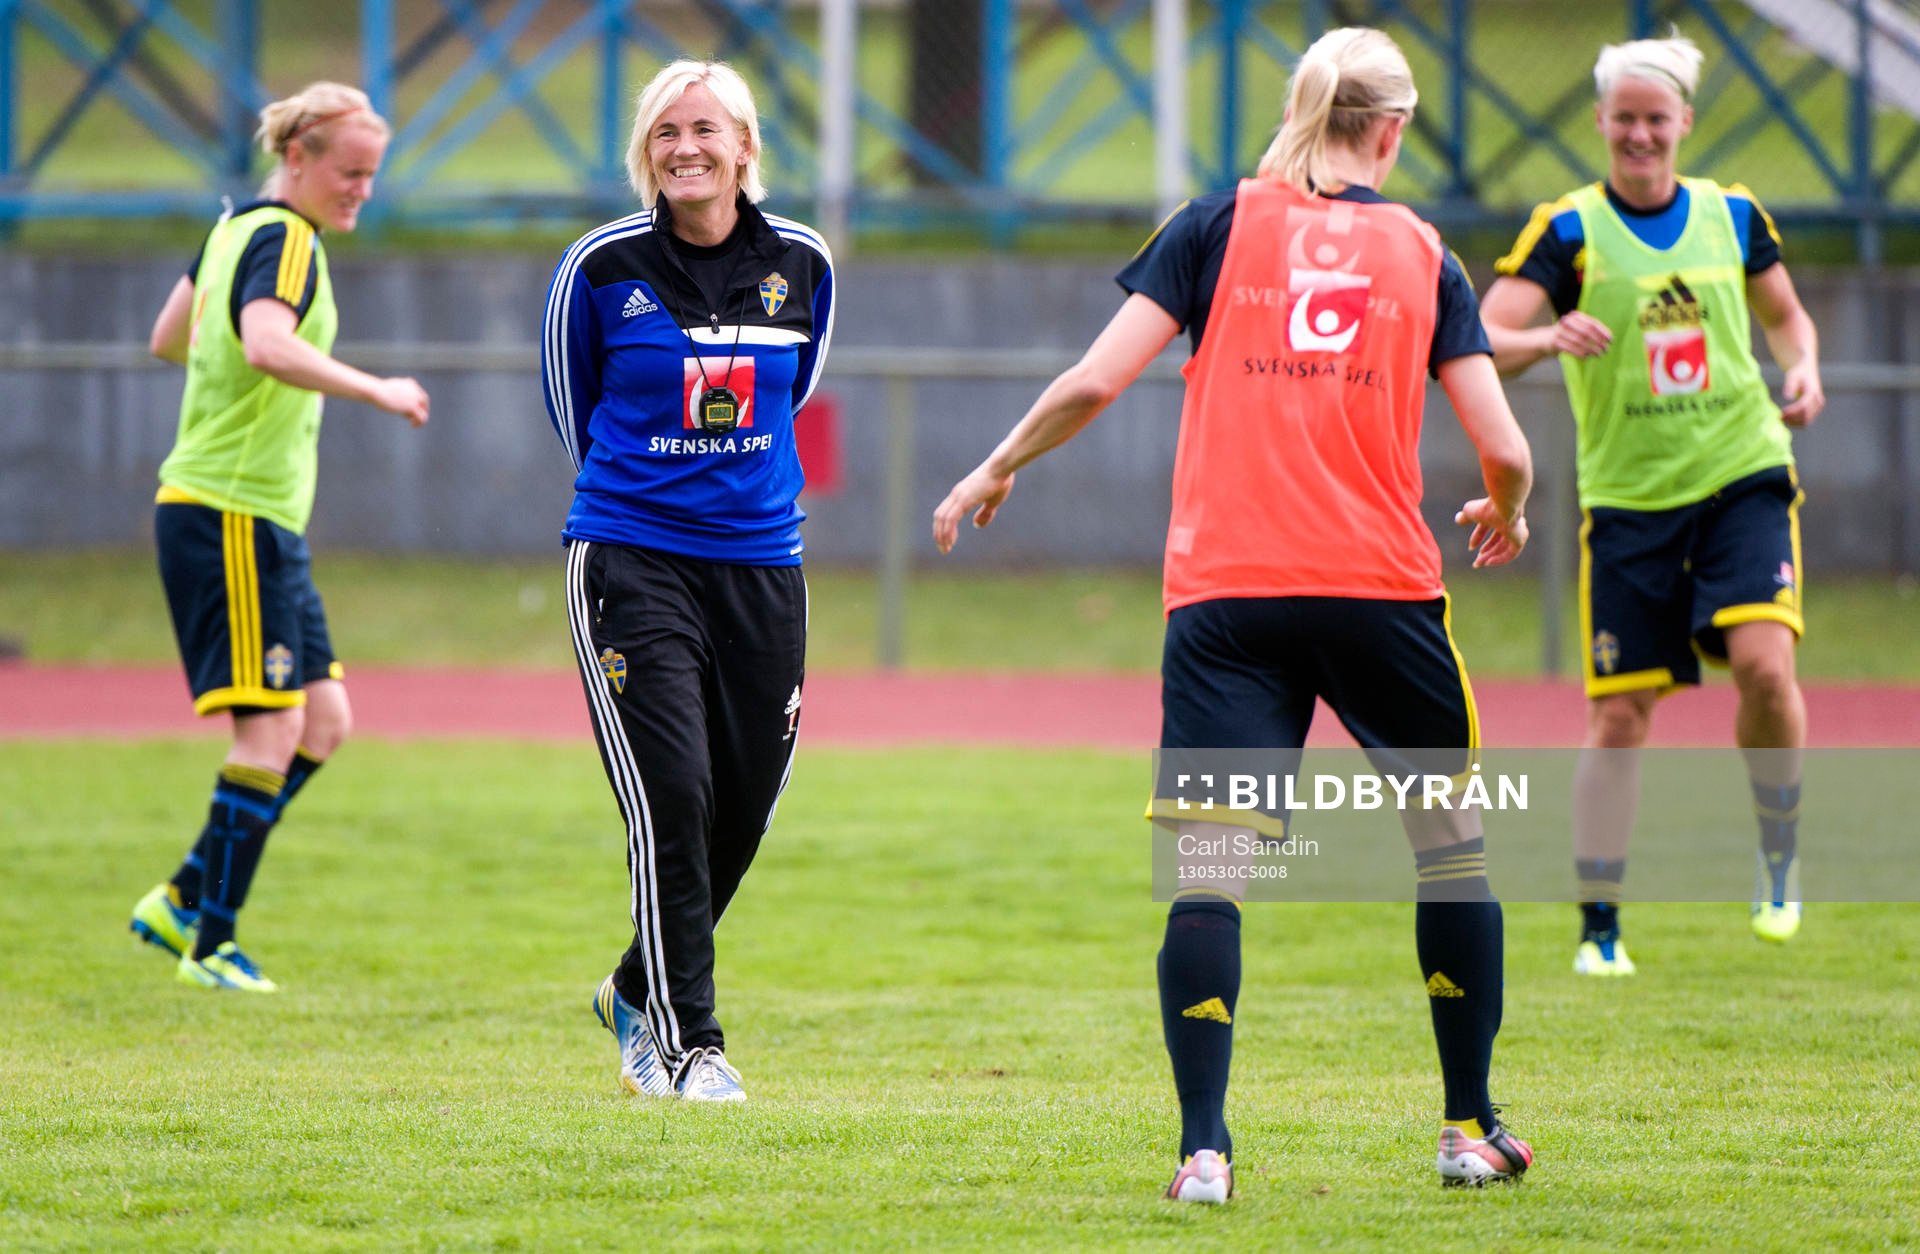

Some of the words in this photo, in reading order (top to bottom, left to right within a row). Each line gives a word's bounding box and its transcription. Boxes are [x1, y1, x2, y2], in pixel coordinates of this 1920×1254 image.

[622, 303, 658, 318] adidas
[1244, 358, 1336, 378] SVENSKA
[648, 436, 737, 454] SVENSKA
